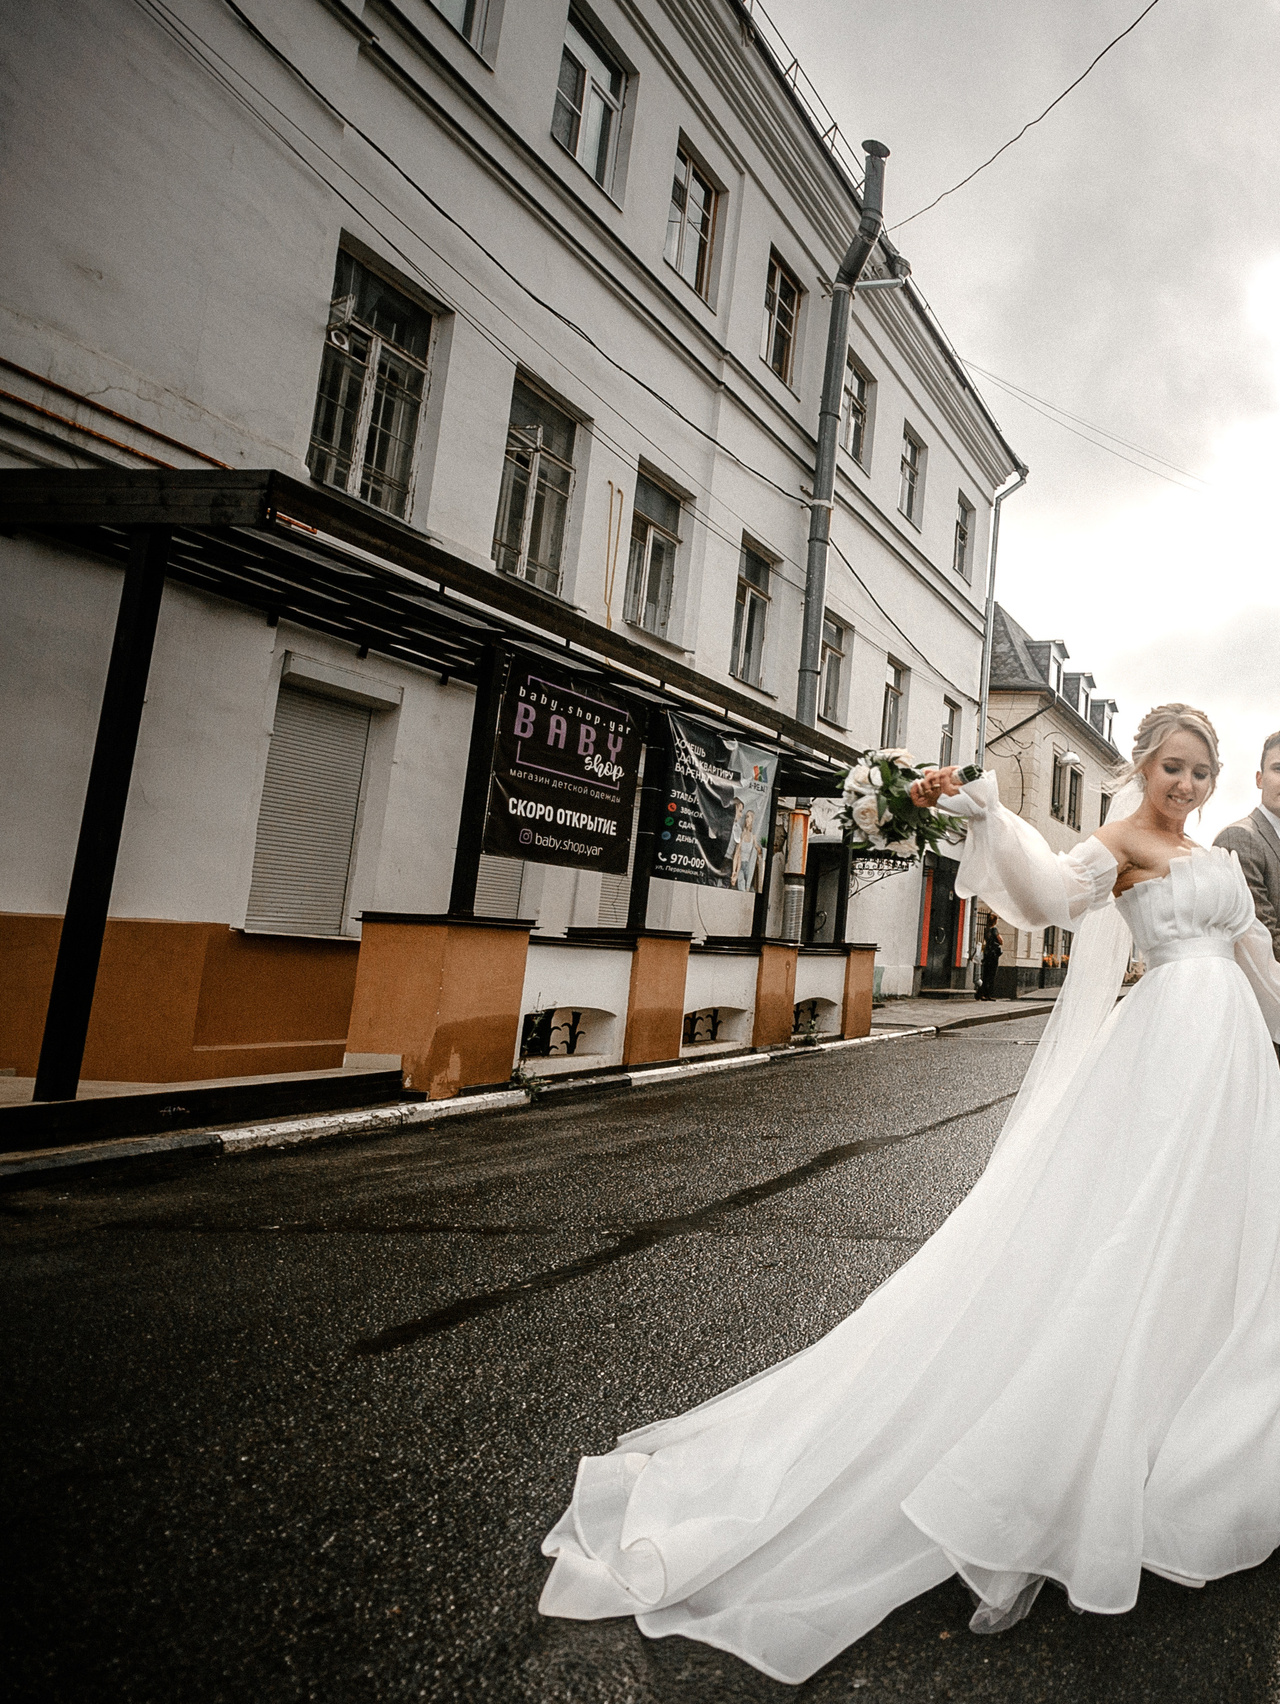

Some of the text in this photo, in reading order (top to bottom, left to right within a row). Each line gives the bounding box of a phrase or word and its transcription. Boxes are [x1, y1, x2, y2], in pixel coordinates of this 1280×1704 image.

[519, 686, 631, 735] baby.shop.yar
[513, 701, 623, 764] BABY
[584, 753, 625, 782] shop
[509, 768, 621, 803] магазин детской одежды
[508, 797, 618, 836] СКОРО ОТКРЫТИЕ
[535, 832, 604, 857] baby.shop.yar
[670, 853, 705, 869] 970-009
